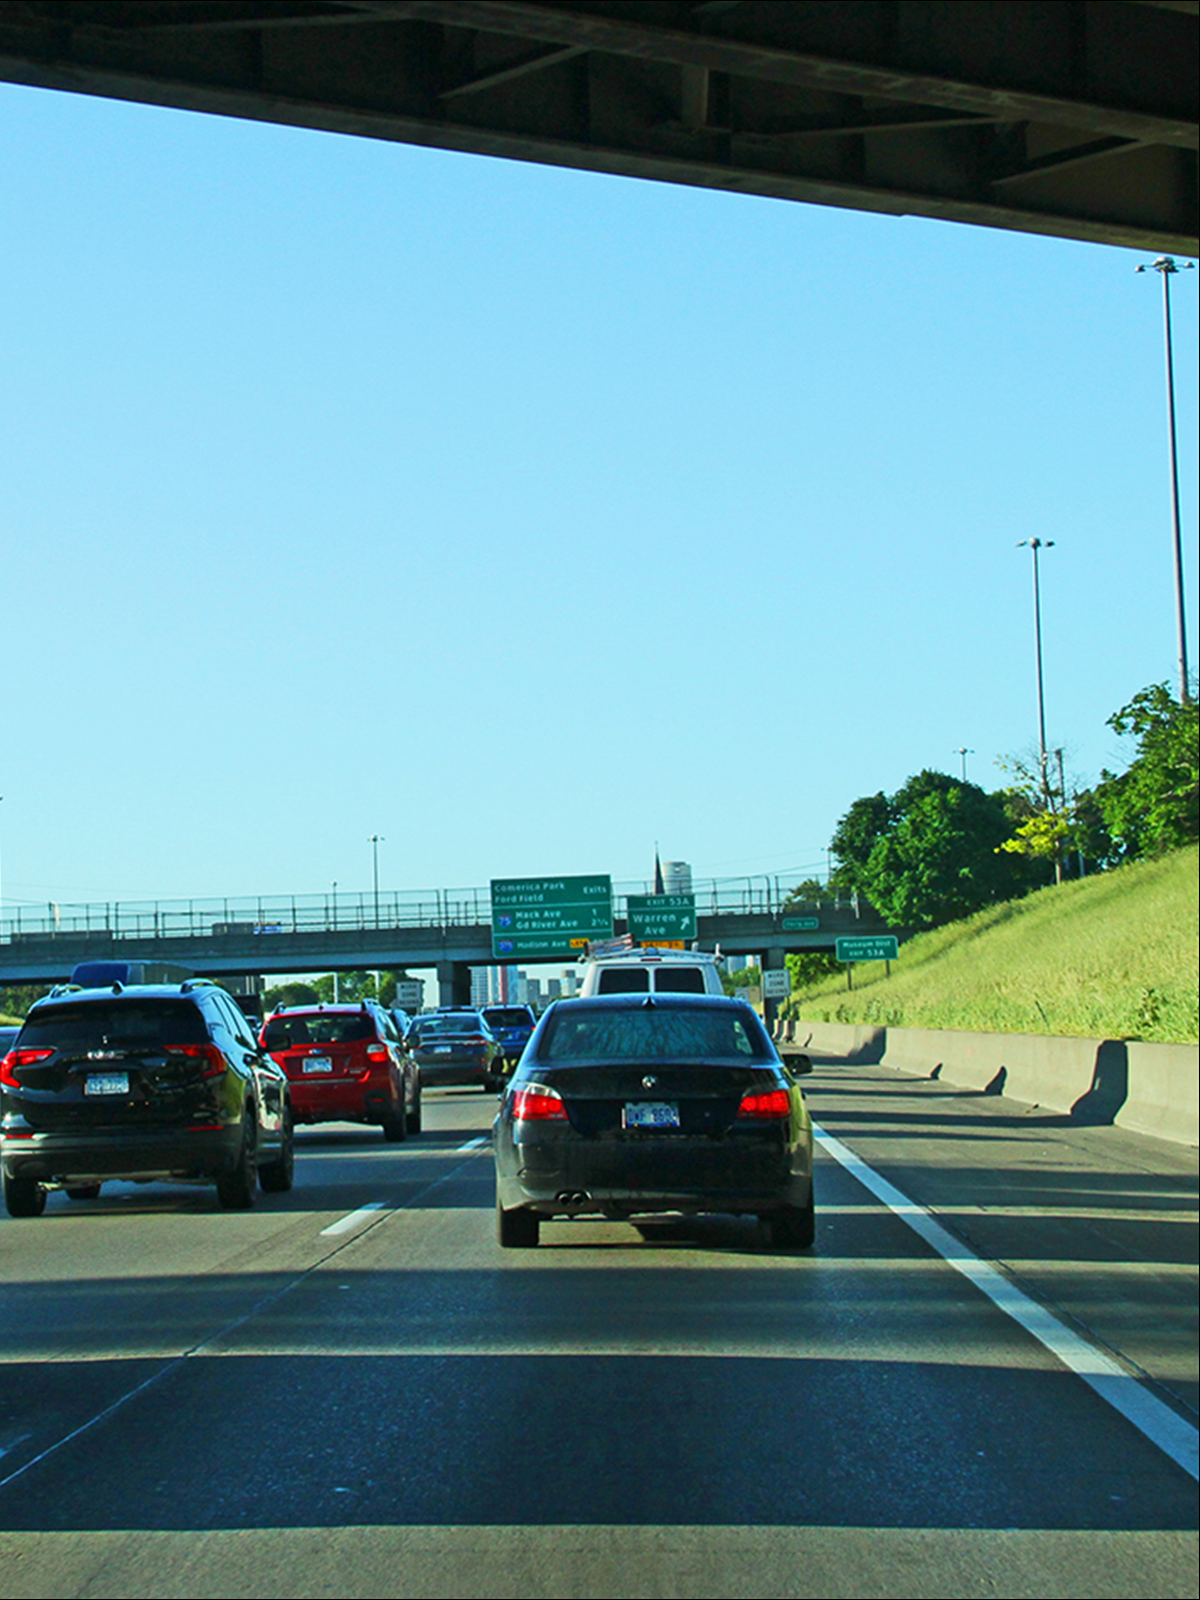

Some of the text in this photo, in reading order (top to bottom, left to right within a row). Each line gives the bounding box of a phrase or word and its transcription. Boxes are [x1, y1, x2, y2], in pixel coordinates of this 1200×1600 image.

[494, 881, 566, 892] Comerica Park
[583, 885, 607, 895] Exits
[494, 893, 544, 903] Ford Field
[669, 897, 690, 906] 53A
[515, 909, 561, 919] Mack Ave
[632, 913, 677, 923] Warren
[515, 919, 578, 930] Gd River Ave
[644, 926, 666, 936] Ave
[517, 940, 566, 949] Madison Ave
[843, 941, 874, 949] Museum
[867, 948, 885, 957] 53A
